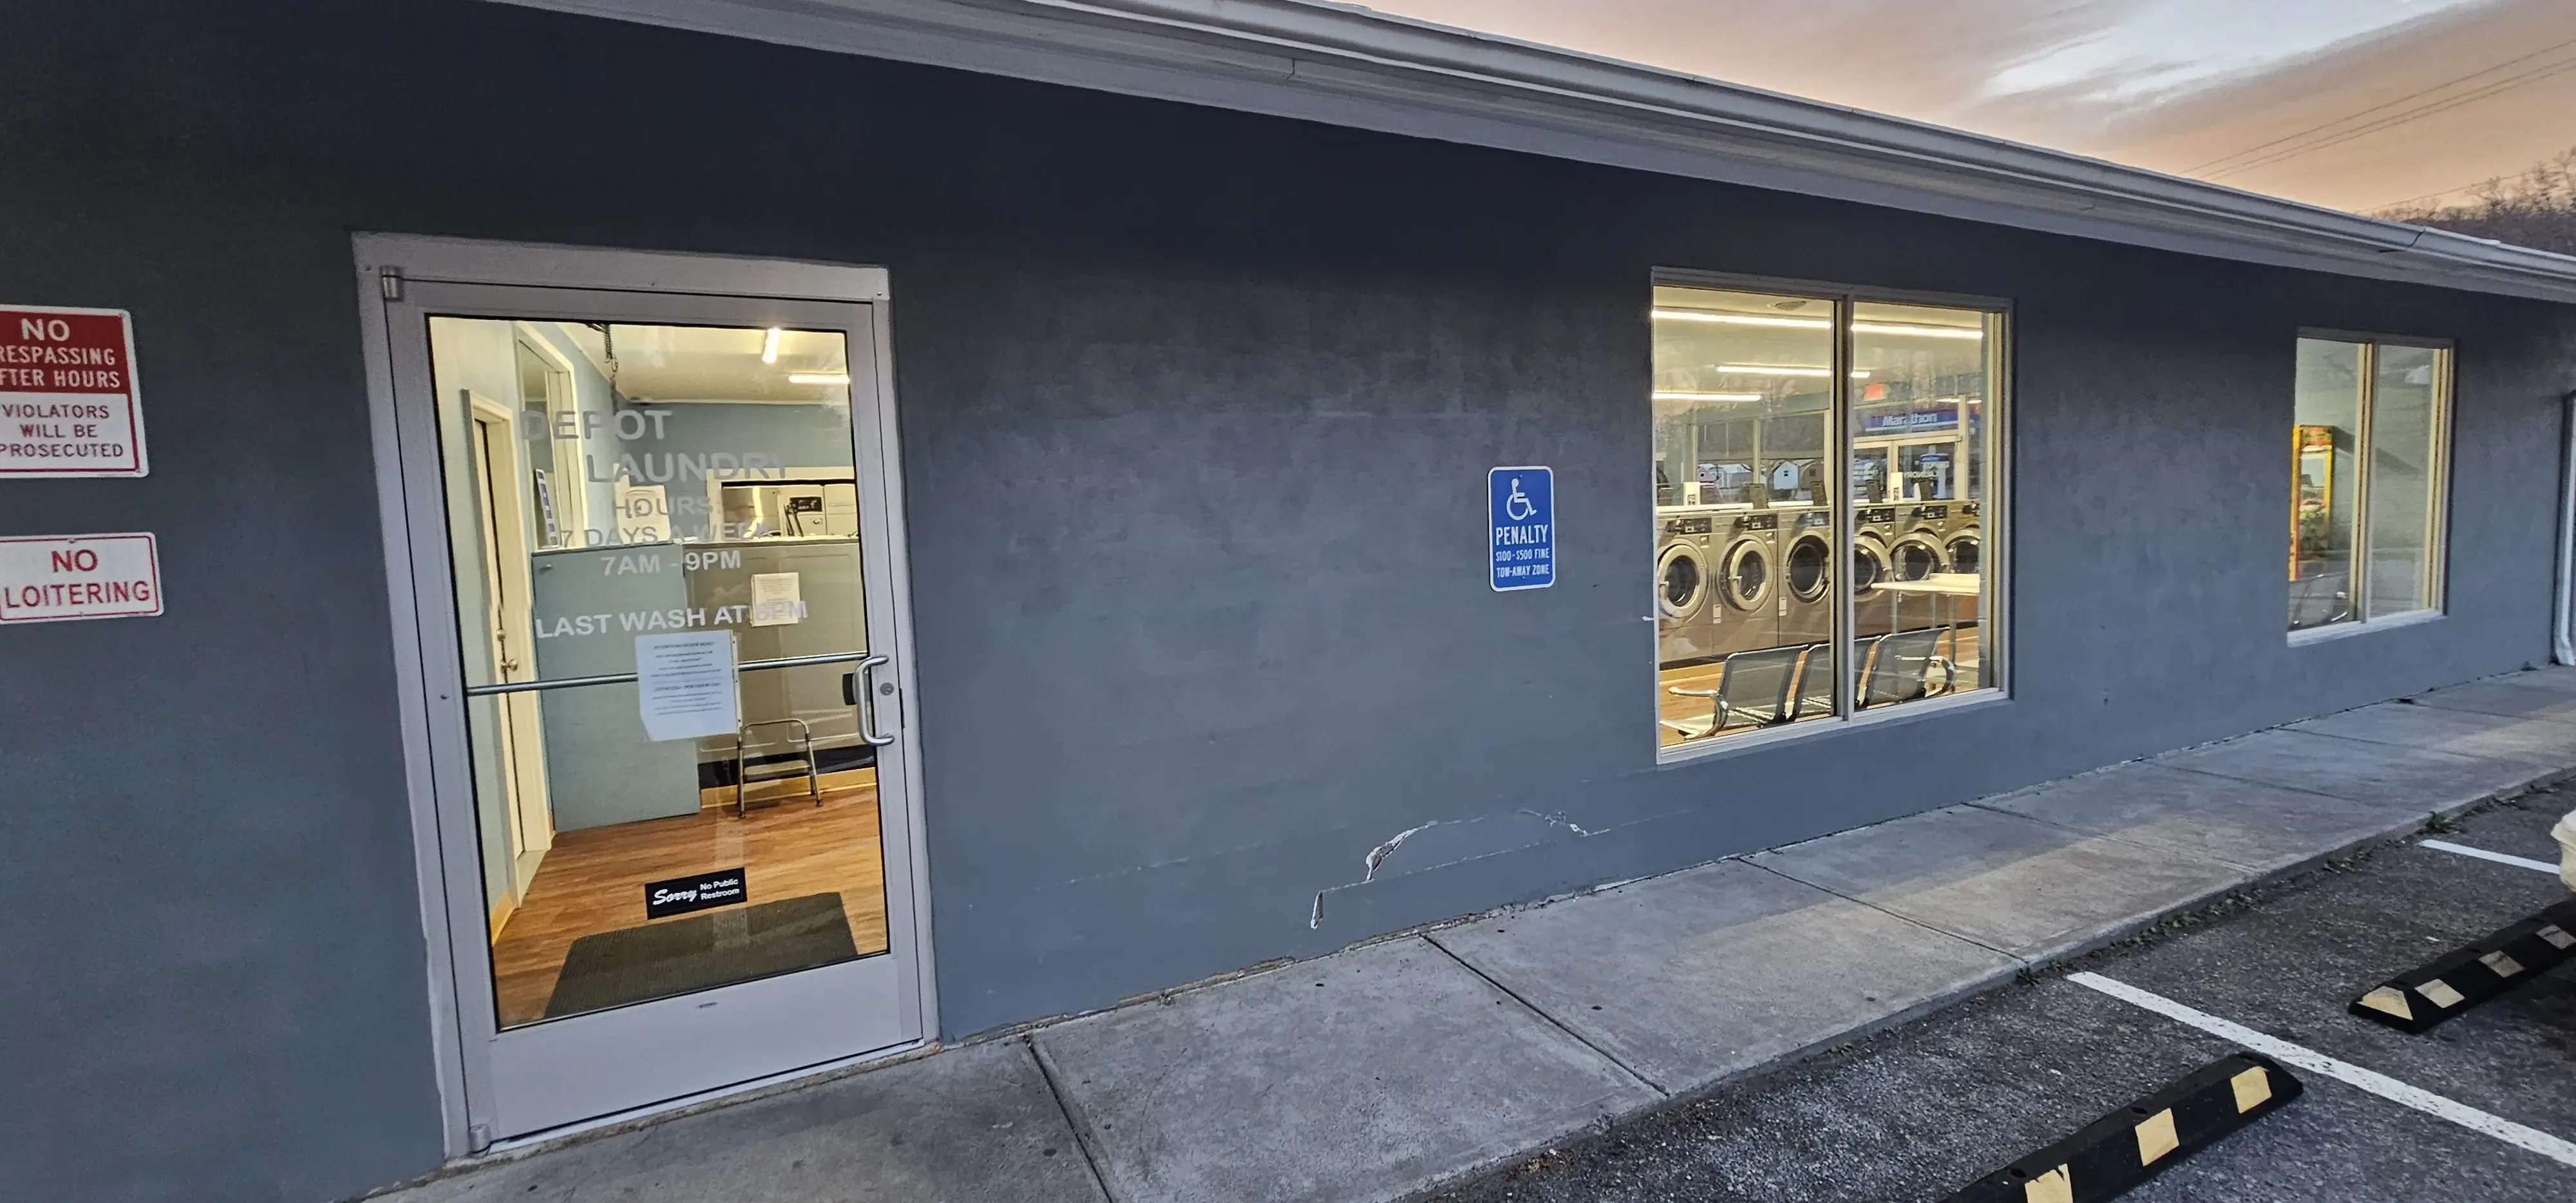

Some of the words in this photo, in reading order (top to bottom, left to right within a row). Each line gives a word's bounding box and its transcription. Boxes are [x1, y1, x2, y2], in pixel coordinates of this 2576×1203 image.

[21, 318, 70, 341] NO
[53, 370, 120, 388] HOURS
[2, 404, 110, 419] VIOLATORS
[19, 424, 66, 438] WILL
[73, 424, 98, 438] BE
[520, 410, 672, 440] DEPOT
[0, 442, 124, 458] PROSECUTED
[587, 451, 790, 483] LAUNDRY
[561, 530, 573, 547] 7
[585, 526, 658, 546] DAYS
[669, 524, 685, 542] A
[1496, 524, 1548, 545] PENALTY
[51, 549, 98, 573] NO
[600, 554, 660, 576] 7AM
[685, 550, 741, 571] 9PM
[1535, 548, 1549, 559] FINE
[1497, 565, 1530, 578] TOW-AWAY
[1532, 564, 1549, 575] ZONE
[5, 580, 149, 609] LOITERING
[536, 614, 612, 638] LAST
[619, 606, 706, 632] WASH
[714, 605, 748, 625] AT
[714, 878, 738, 888] Public
[652, 889, 697, 905] Sorry
[701, 889, 740, 900] Restroom
